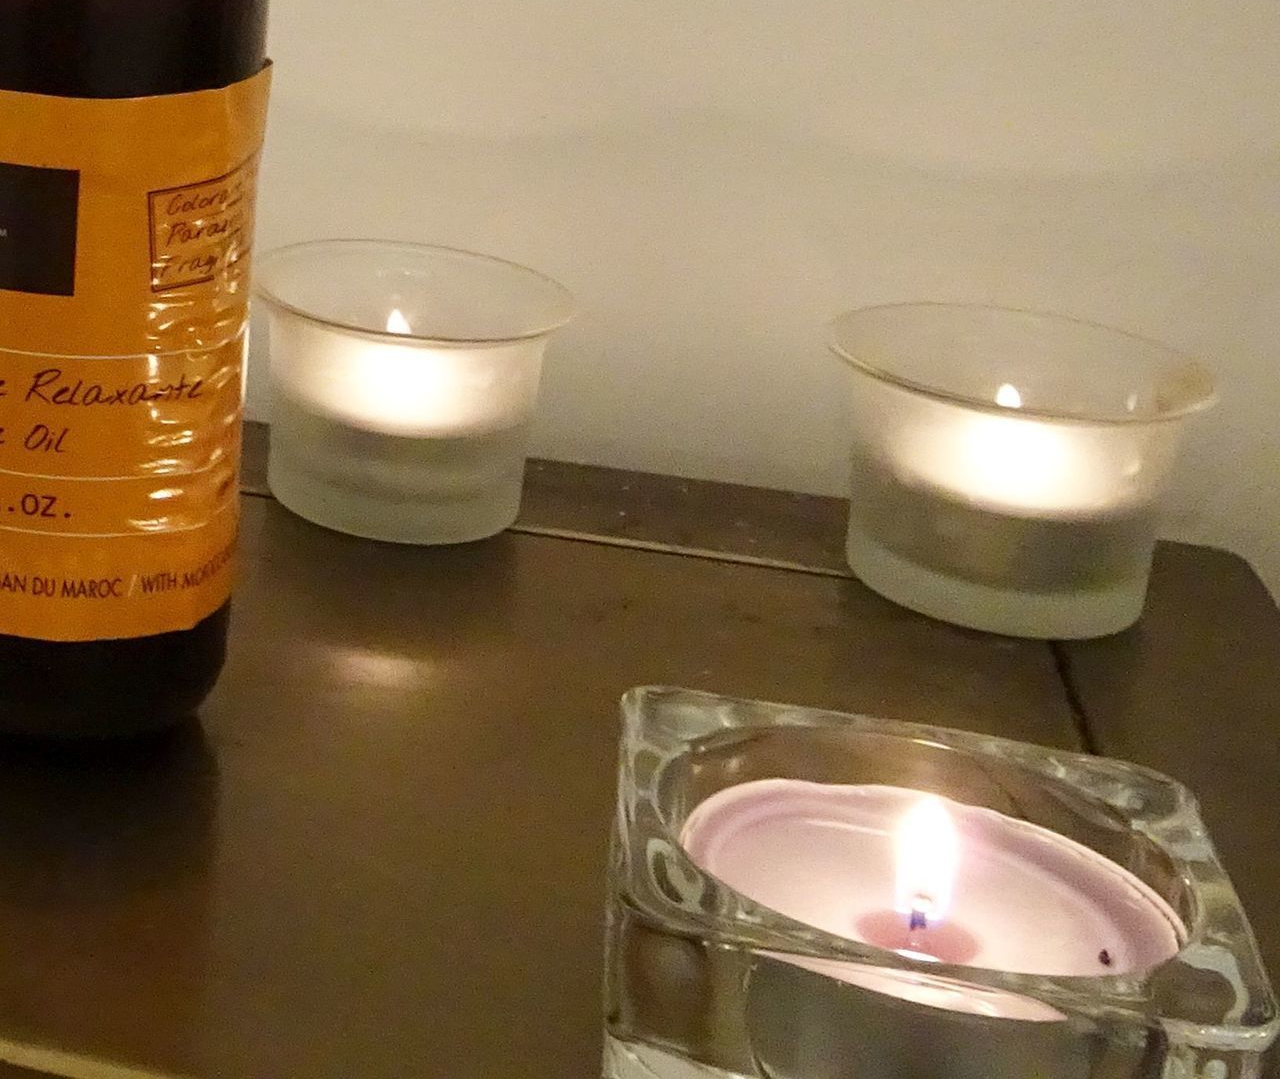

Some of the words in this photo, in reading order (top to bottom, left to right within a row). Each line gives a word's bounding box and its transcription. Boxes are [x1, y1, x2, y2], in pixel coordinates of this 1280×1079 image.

[24, 368, 204, 406] Relaxante
[24, 423, 70, 453] Oil
[31, 576, 56, 598] DU
[60, 577, 123, 599] MAROC
[141, 572, 177, 594] WITH
